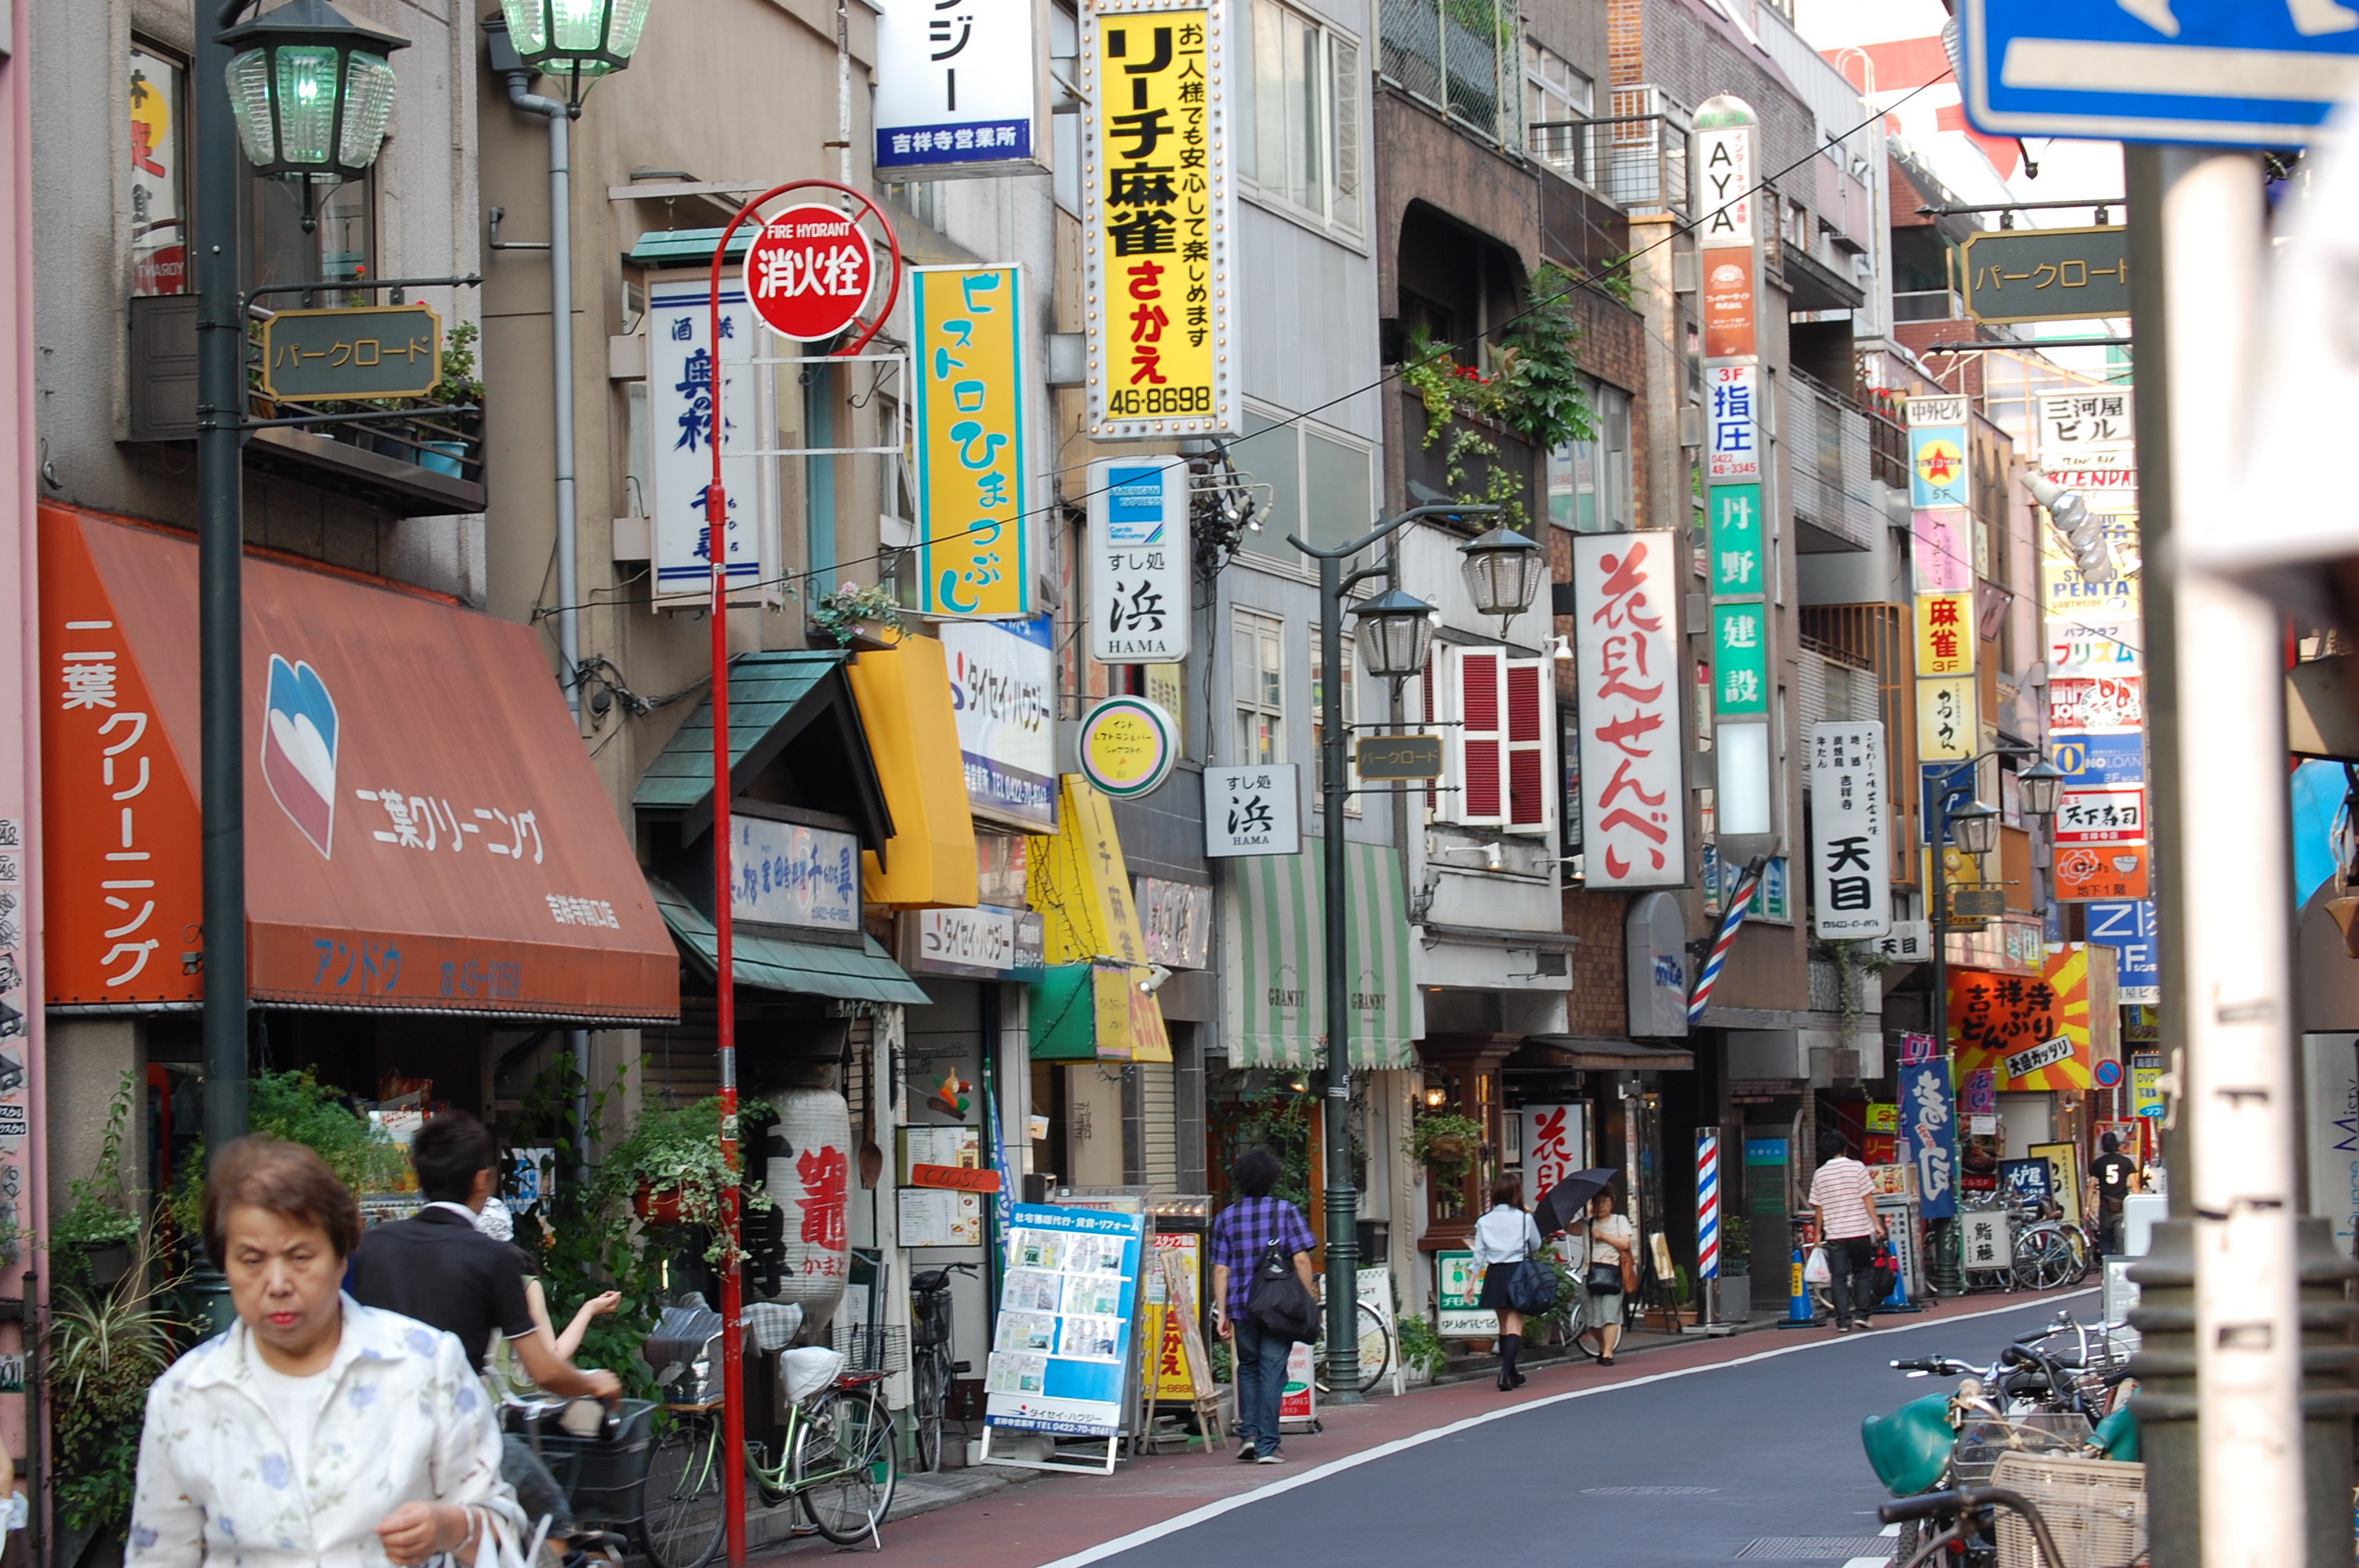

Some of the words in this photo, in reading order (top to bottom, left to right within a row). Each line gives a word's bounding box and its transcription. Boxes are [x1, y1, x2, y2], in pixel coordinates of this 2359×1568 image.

[930, 0, 973, 111] ジー
[891, 126, 1018, 155] 吉祥寺営業所
[1105, 26, 1179, 257] リーチ麻雀
[1178, 23, 1209, 348] お一人様でも安心して楽しめます
[1708, 140, 1735, 234] AYA
[766, 224, 793, 239] FIRE
[795, 221, 851, 238] HYDRANT
[756, 244, 864, 300] 消火栓
[1127, 260, 1169, 386] さかえ
[276, 336, 430, 369] パークロード
[1719, 368, 1744, 382] 3F
[1713, 385, 1752, 453] 指圧
[1912, 401, 1963, 422] 中外ビル
[2047, 396, 2124, 420] 三河屋
[934, 271, 1008, 613] ビストロひまつぶし
[2056, 419, 2118, 442] ビル
[1712, 463, 1757, 475] 48-3345
[1109, 485, 1160, 496] AMERICAN
[1119, 497, 1163, 508] EXPRESS
[1108, 551, 1166, 571] すし処
[1720, 496, 1760, 704] 丹野建設
[2053, 580, 2131, 598] PENTA
[1109, 579, 1167, 633] 浜
[1929, 598, 1960, 659] 麻雀
[1108, 639, 1167, 653] HAMA
[2052, 642, 2135, 666] プリズム
[1932, 660, 1960, 672] 3F
[1592, 540, 1669, 879] 花見せんべい
[1361, 748, 1439, 766] パークロード
[1226, 774, 1272, 791] すし処
[1840, 775, 1853, 811] 吉祥寺
[62, 620, 160, 987] 二葉クリーニング
[1228, 795, 1274, 835] 浜
[355, 788, 544, 865] 二葉クリーニング
[2062, 804, 2139, 830] 天下寿司
[1232, 835, 1270, 846] HAMA
[1826, 836, 1871, 911] 天目
[945, 913, 1010, 961] タイセイ・ハウジー
[1880, 936, 1918, 955] 天目
[314, 937, 402, 993] アンドウ
[1268, 988, 1305, 1008] GRANNY
[1351, 992, 1386, 1011] GRANNY
[1966, 979, 2055, 1013] 吉祥寺
[1962, 1006, 2055, 1051] どんぶり
[2137, 1072, 2157, 1083] DVD
[923, 1167, 983, 1188] CLOSE
[2008, 1164, 2045, 1186] 大戸屋
[2105, 1163, 2120, 1185] 5
[1029, 1409, 1103, 1424] タイセイ・ハウジー
[1036, 1420, 1052, 1431] TEL
[1053, 1422, 1109, 1435] 0422-70-8161
